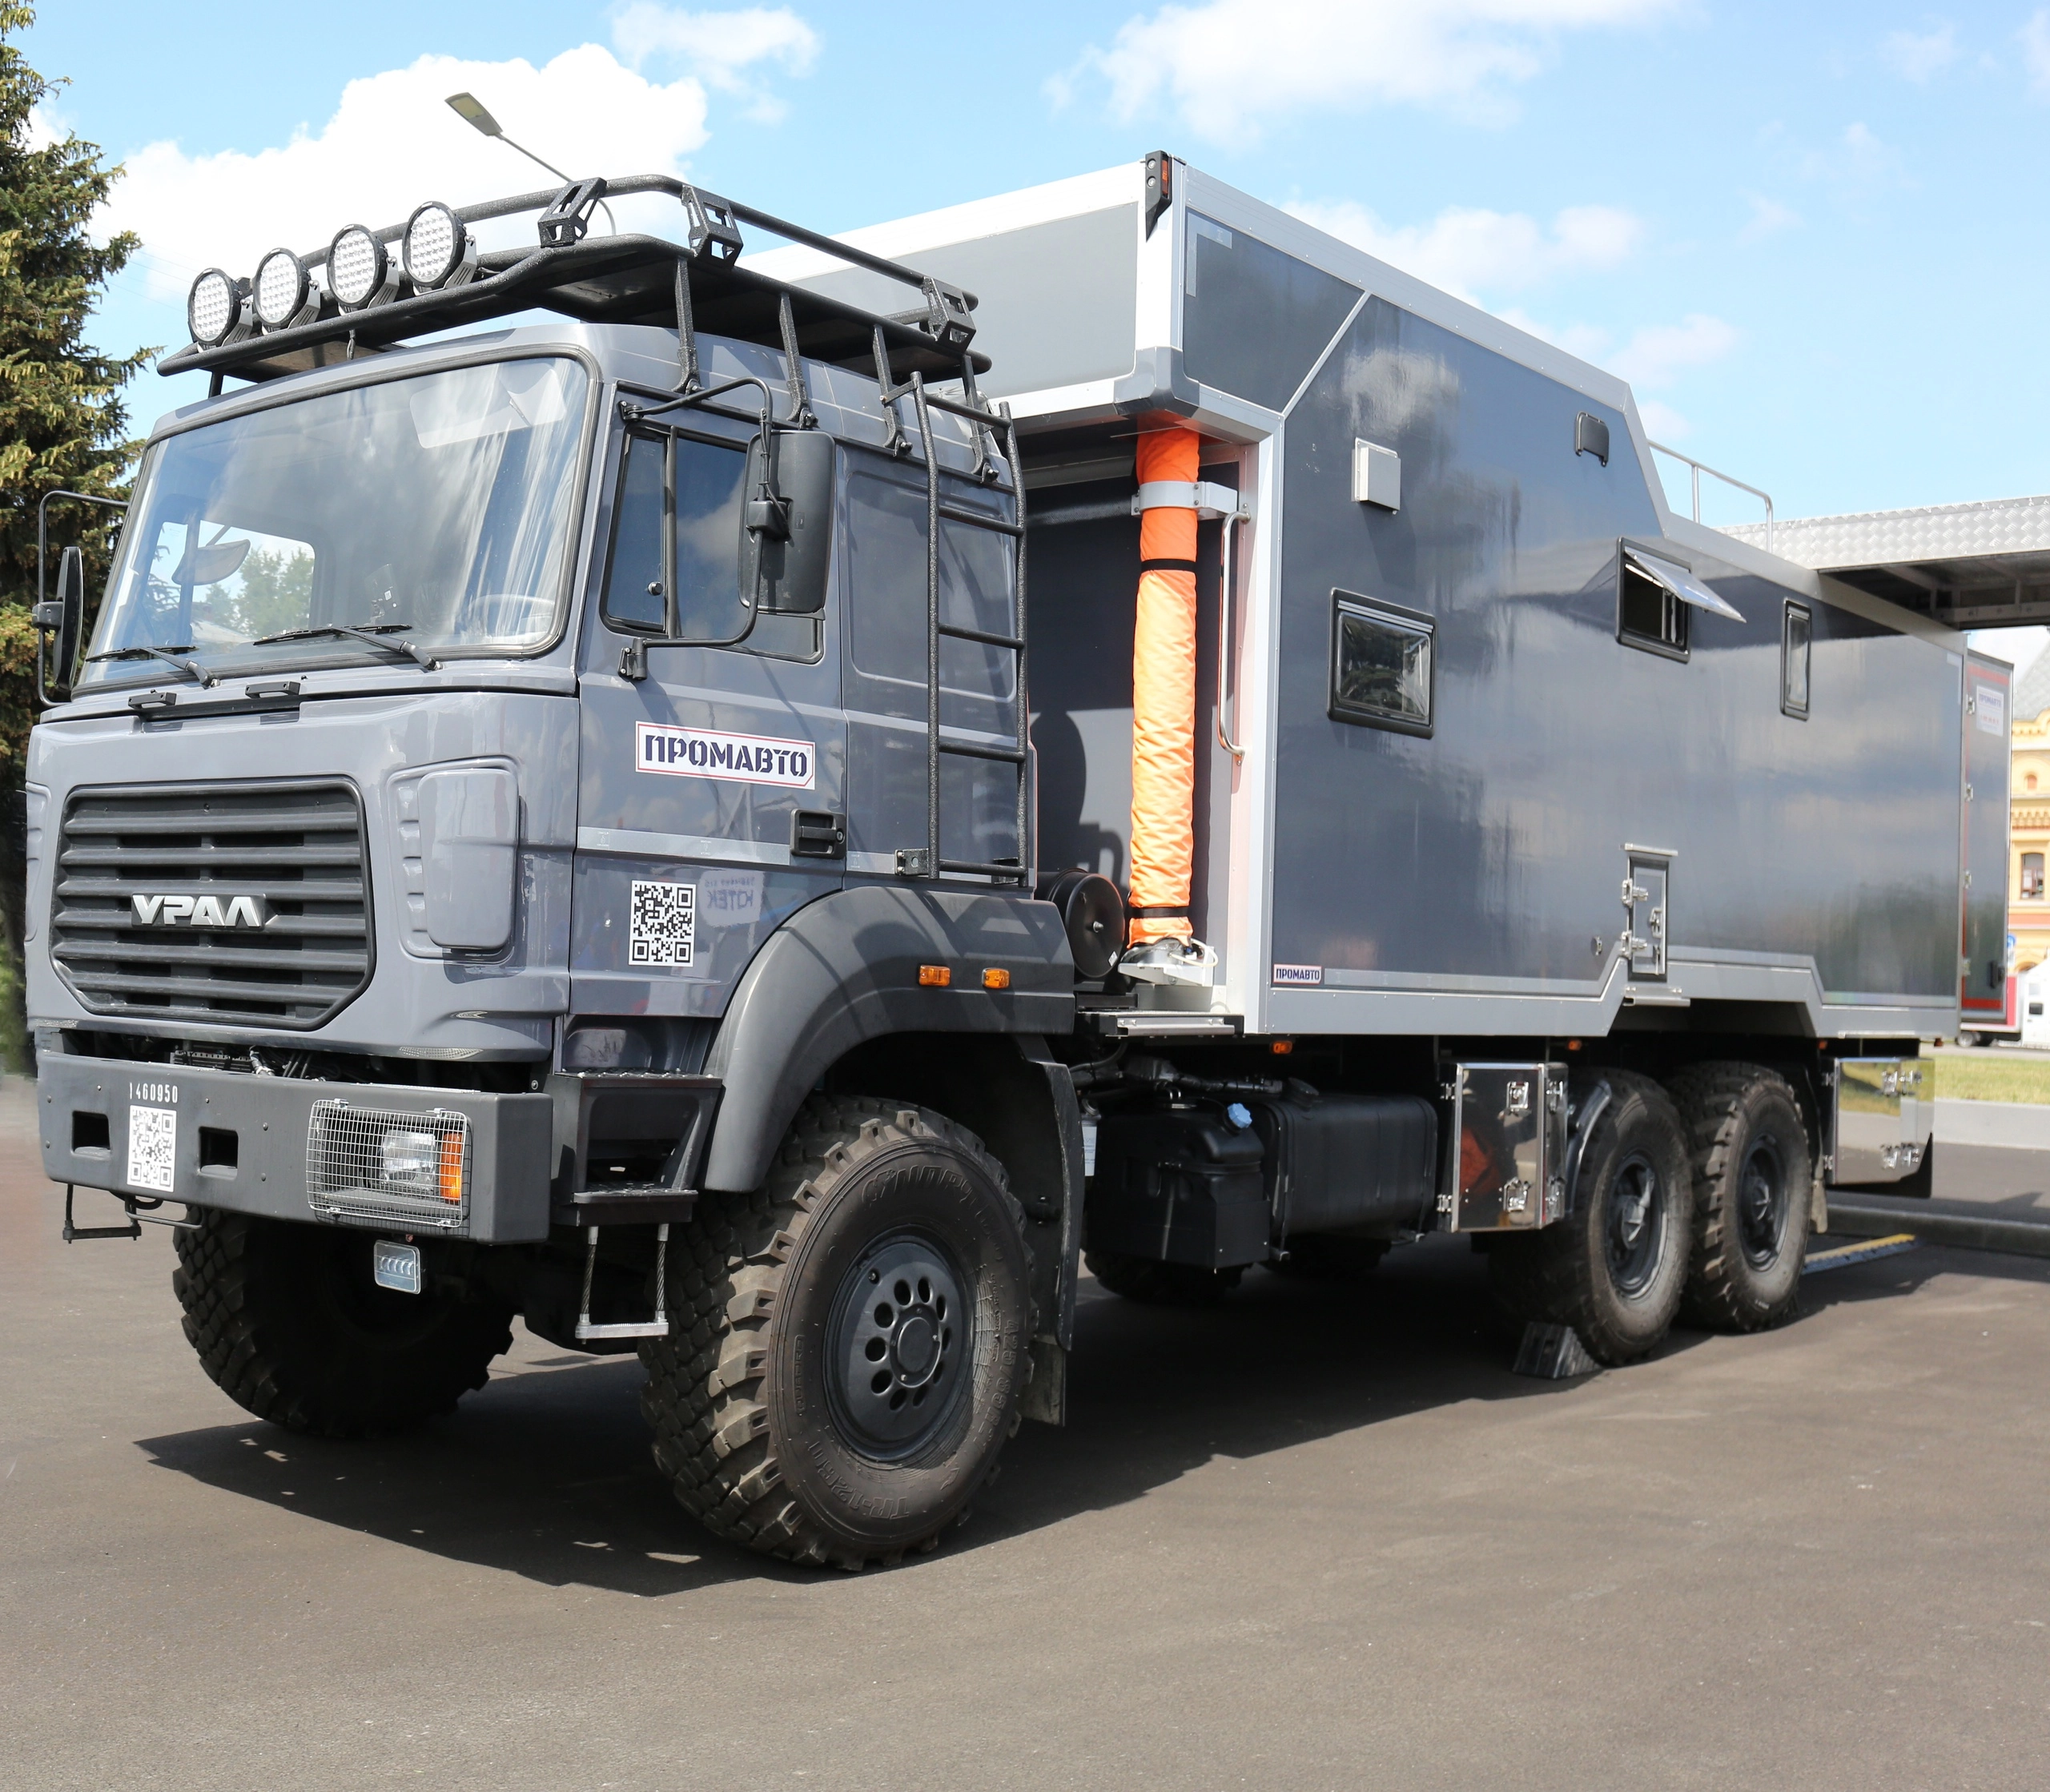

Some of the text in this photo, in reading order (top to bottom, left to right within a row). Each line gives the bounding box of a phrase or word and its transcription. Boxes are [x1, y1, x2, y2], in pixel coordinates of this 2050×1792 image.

[645, 734, 807, 777] ПРОМАВТО
[132, 894, 260, 927] УРАЛ
[1276, 968, 1320, 980] ПРОМАВТО
[129, 1082, 178, 1103] 1460950
